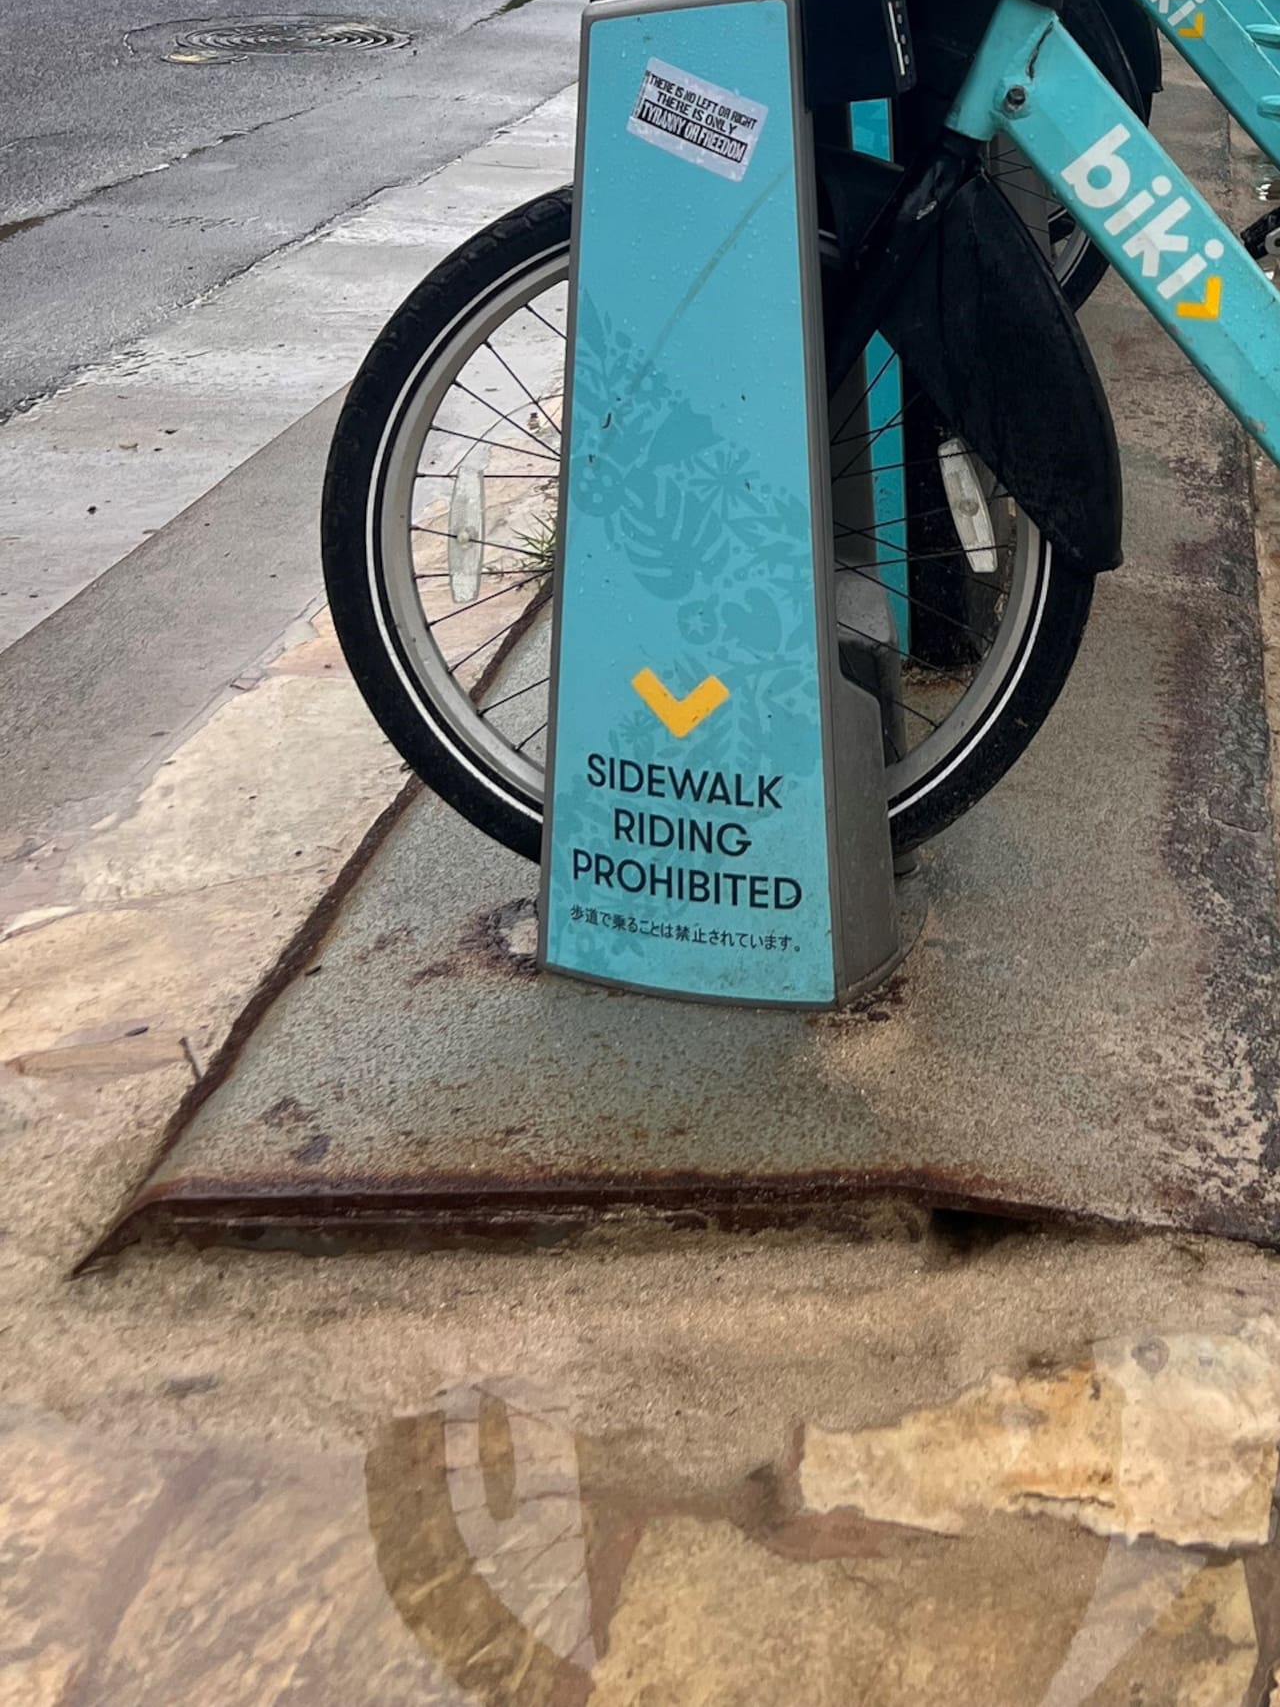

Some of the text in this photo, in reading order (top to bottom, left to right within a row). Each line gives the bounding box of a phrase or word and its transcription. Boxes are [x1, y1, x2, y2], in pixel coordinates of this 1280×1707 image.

[650, 74, 757, 130] THERE IS NO LEFT OR RIGHT
[657, 91, 690, 116] THERE
[692, 108, 704, 121] IS
[706, 114, 737, 135] ONLY
[641, 103, 747, 162] TYRANNY OR FREEDOM
[1060, 123, 1224, 299] biki
[587, 753, 784, 809] SIDEWALK
[614, 808, 752, 857] RIDING
[573, 848, 802, 911] PROHIBITED
